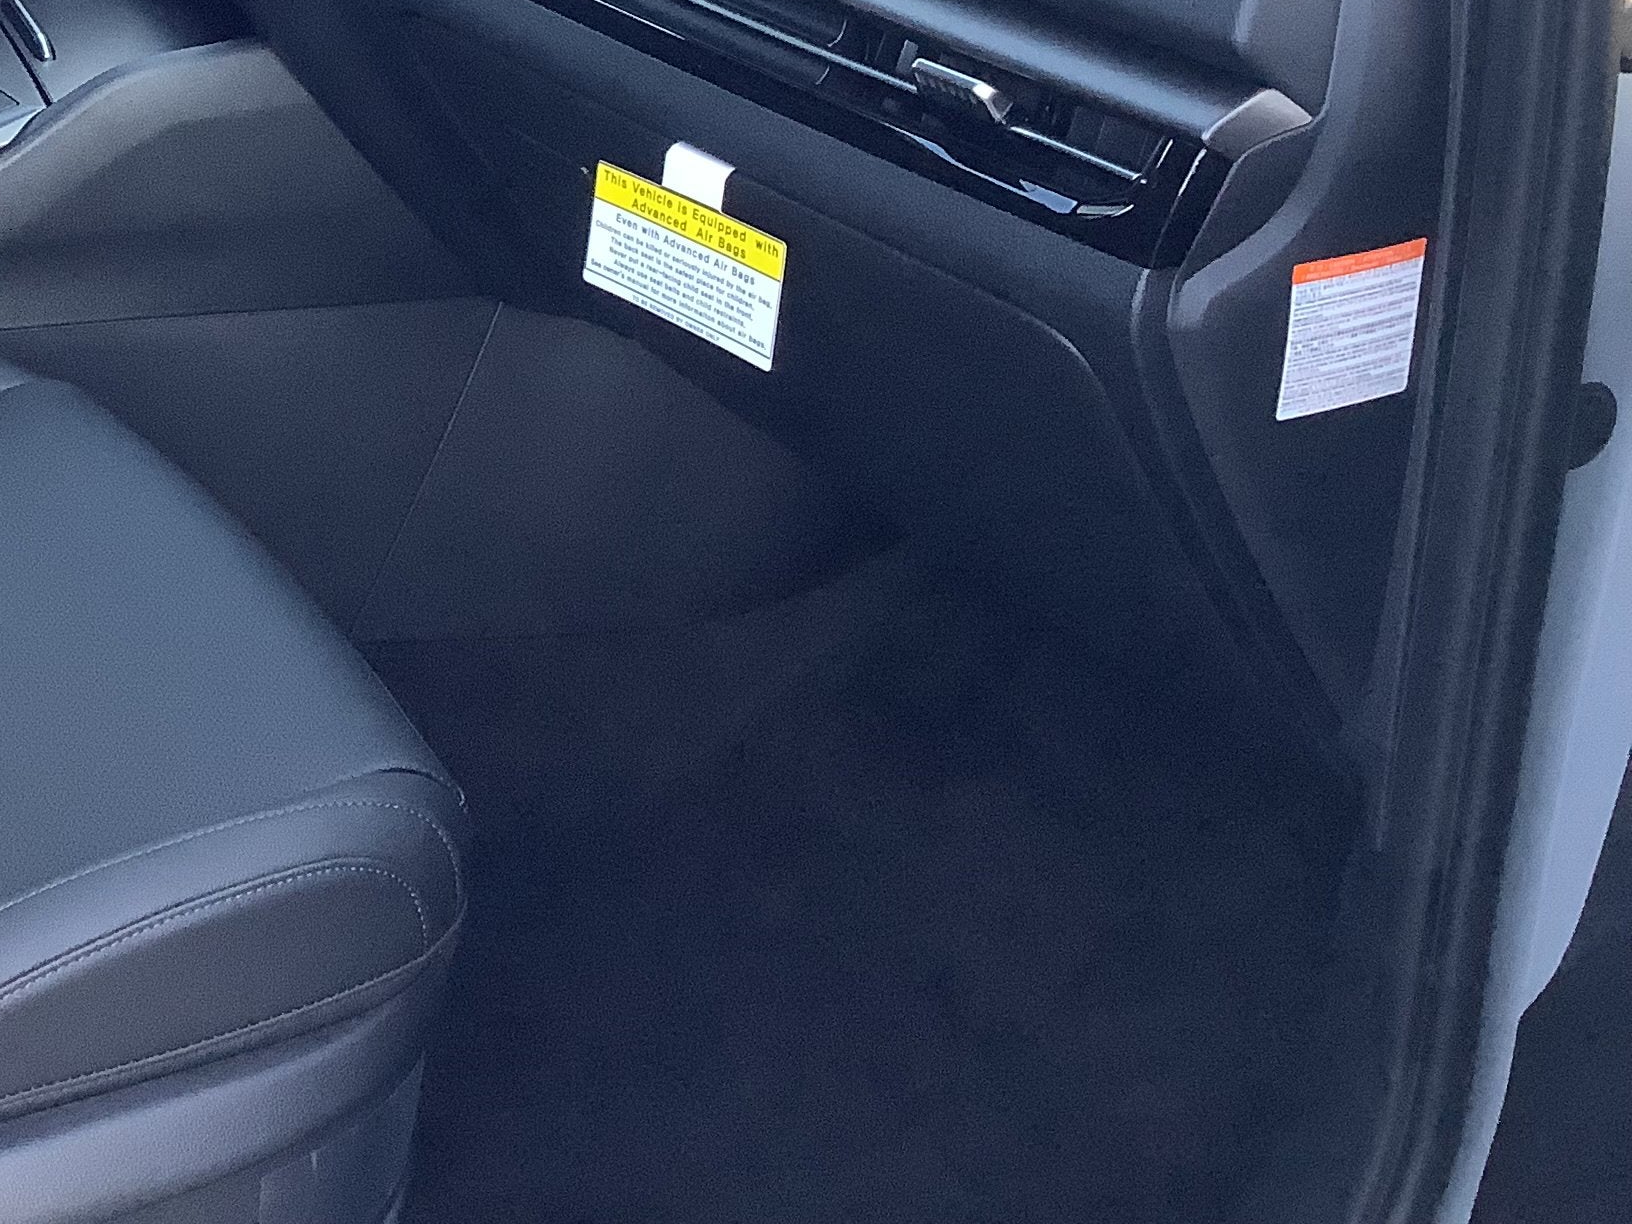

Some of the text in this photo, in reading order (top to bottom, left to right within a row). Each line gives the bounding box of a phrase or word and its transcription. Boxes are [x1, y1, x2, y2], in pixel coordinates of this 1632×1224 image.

[603, 169, 779, 258] This Vehicle is Equipped with
[615, 212, 755, 287] Even with Advanced Air Bags
[631, 196, 746, 260] Advanced Air Bags
